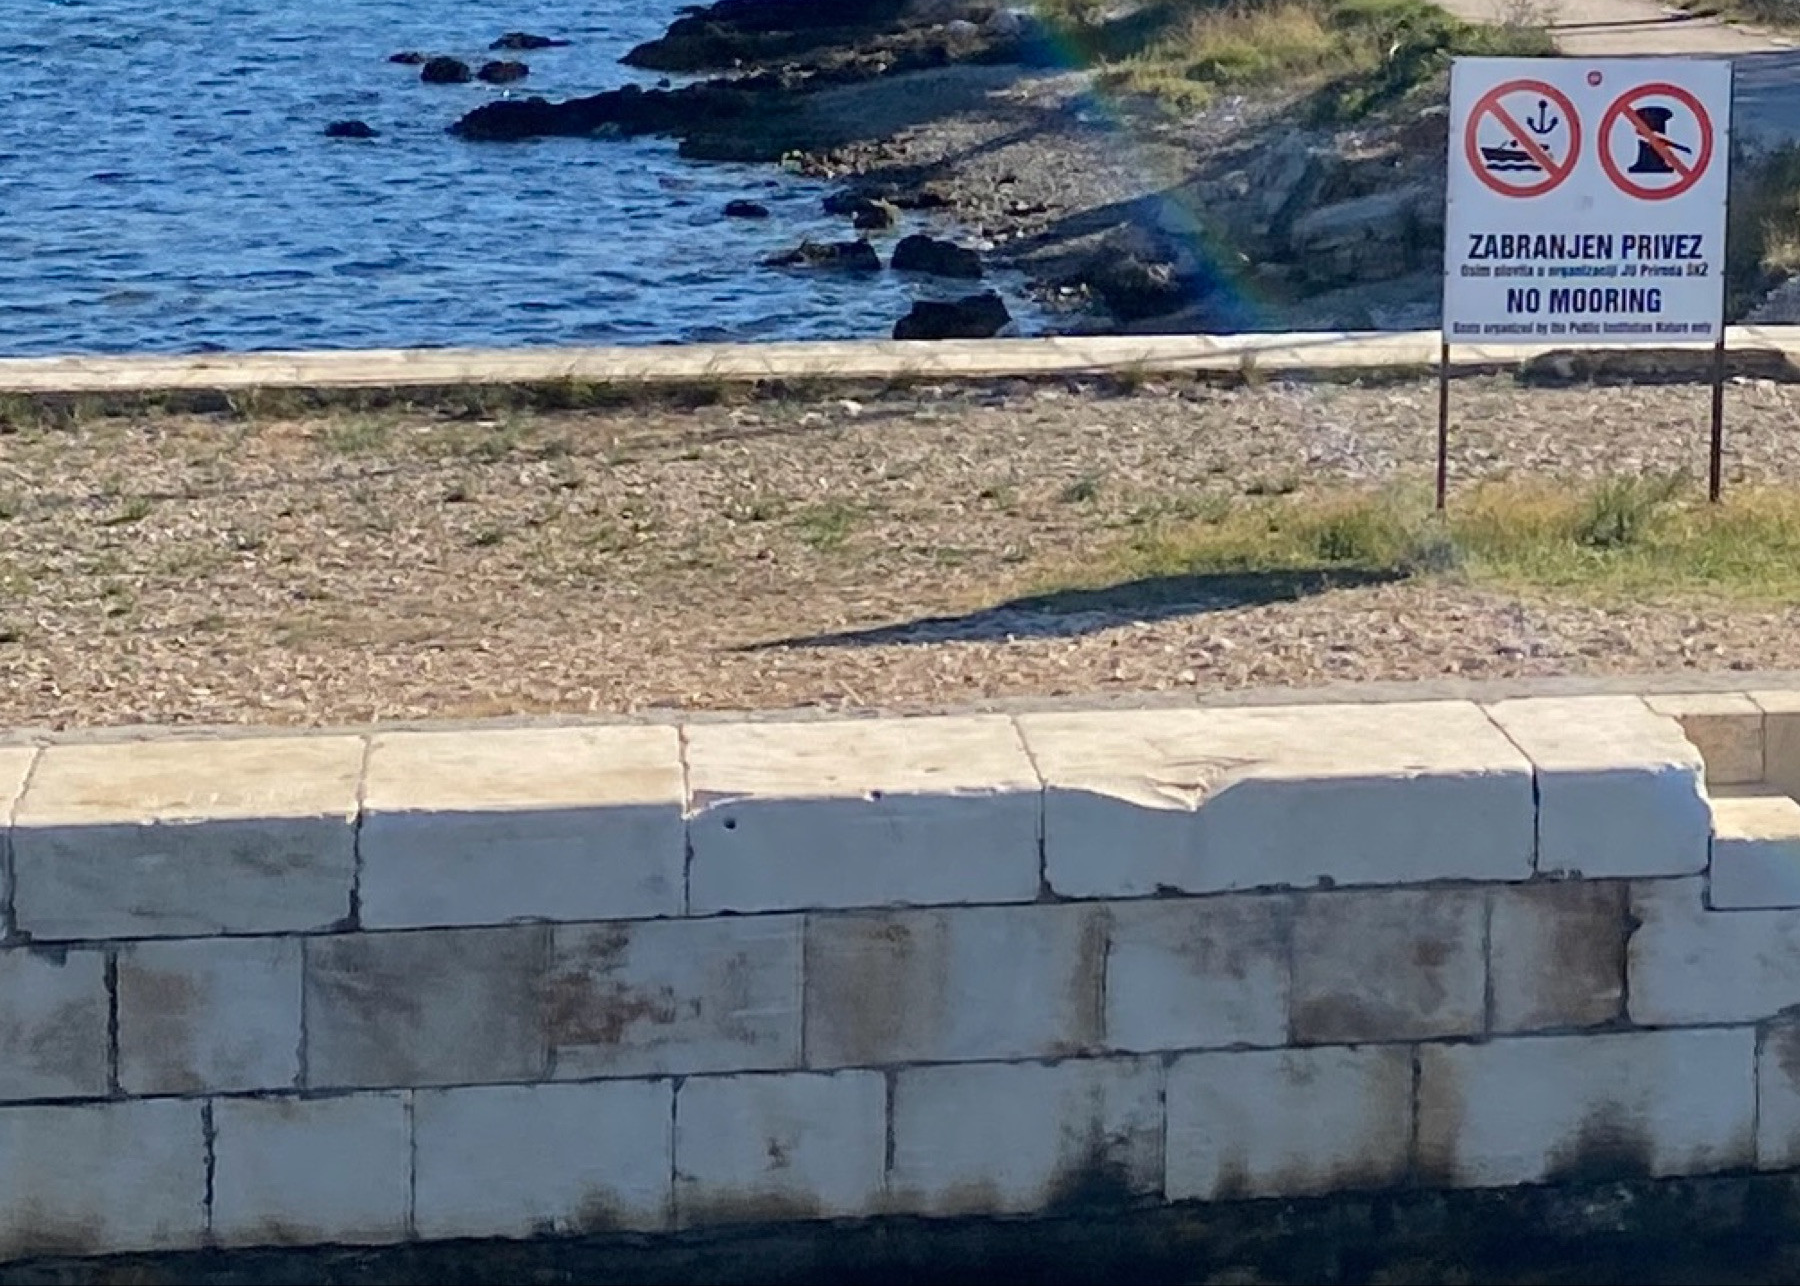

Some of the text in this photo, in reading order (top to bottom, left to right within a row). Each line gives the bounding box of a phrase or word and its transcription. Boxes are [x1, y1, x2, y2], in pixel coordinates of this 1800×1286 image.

[1468, 234, 1703, 260] ZABRANJEN PRIVEZ
[1506, 288, 1662, 314] NO MOORING
